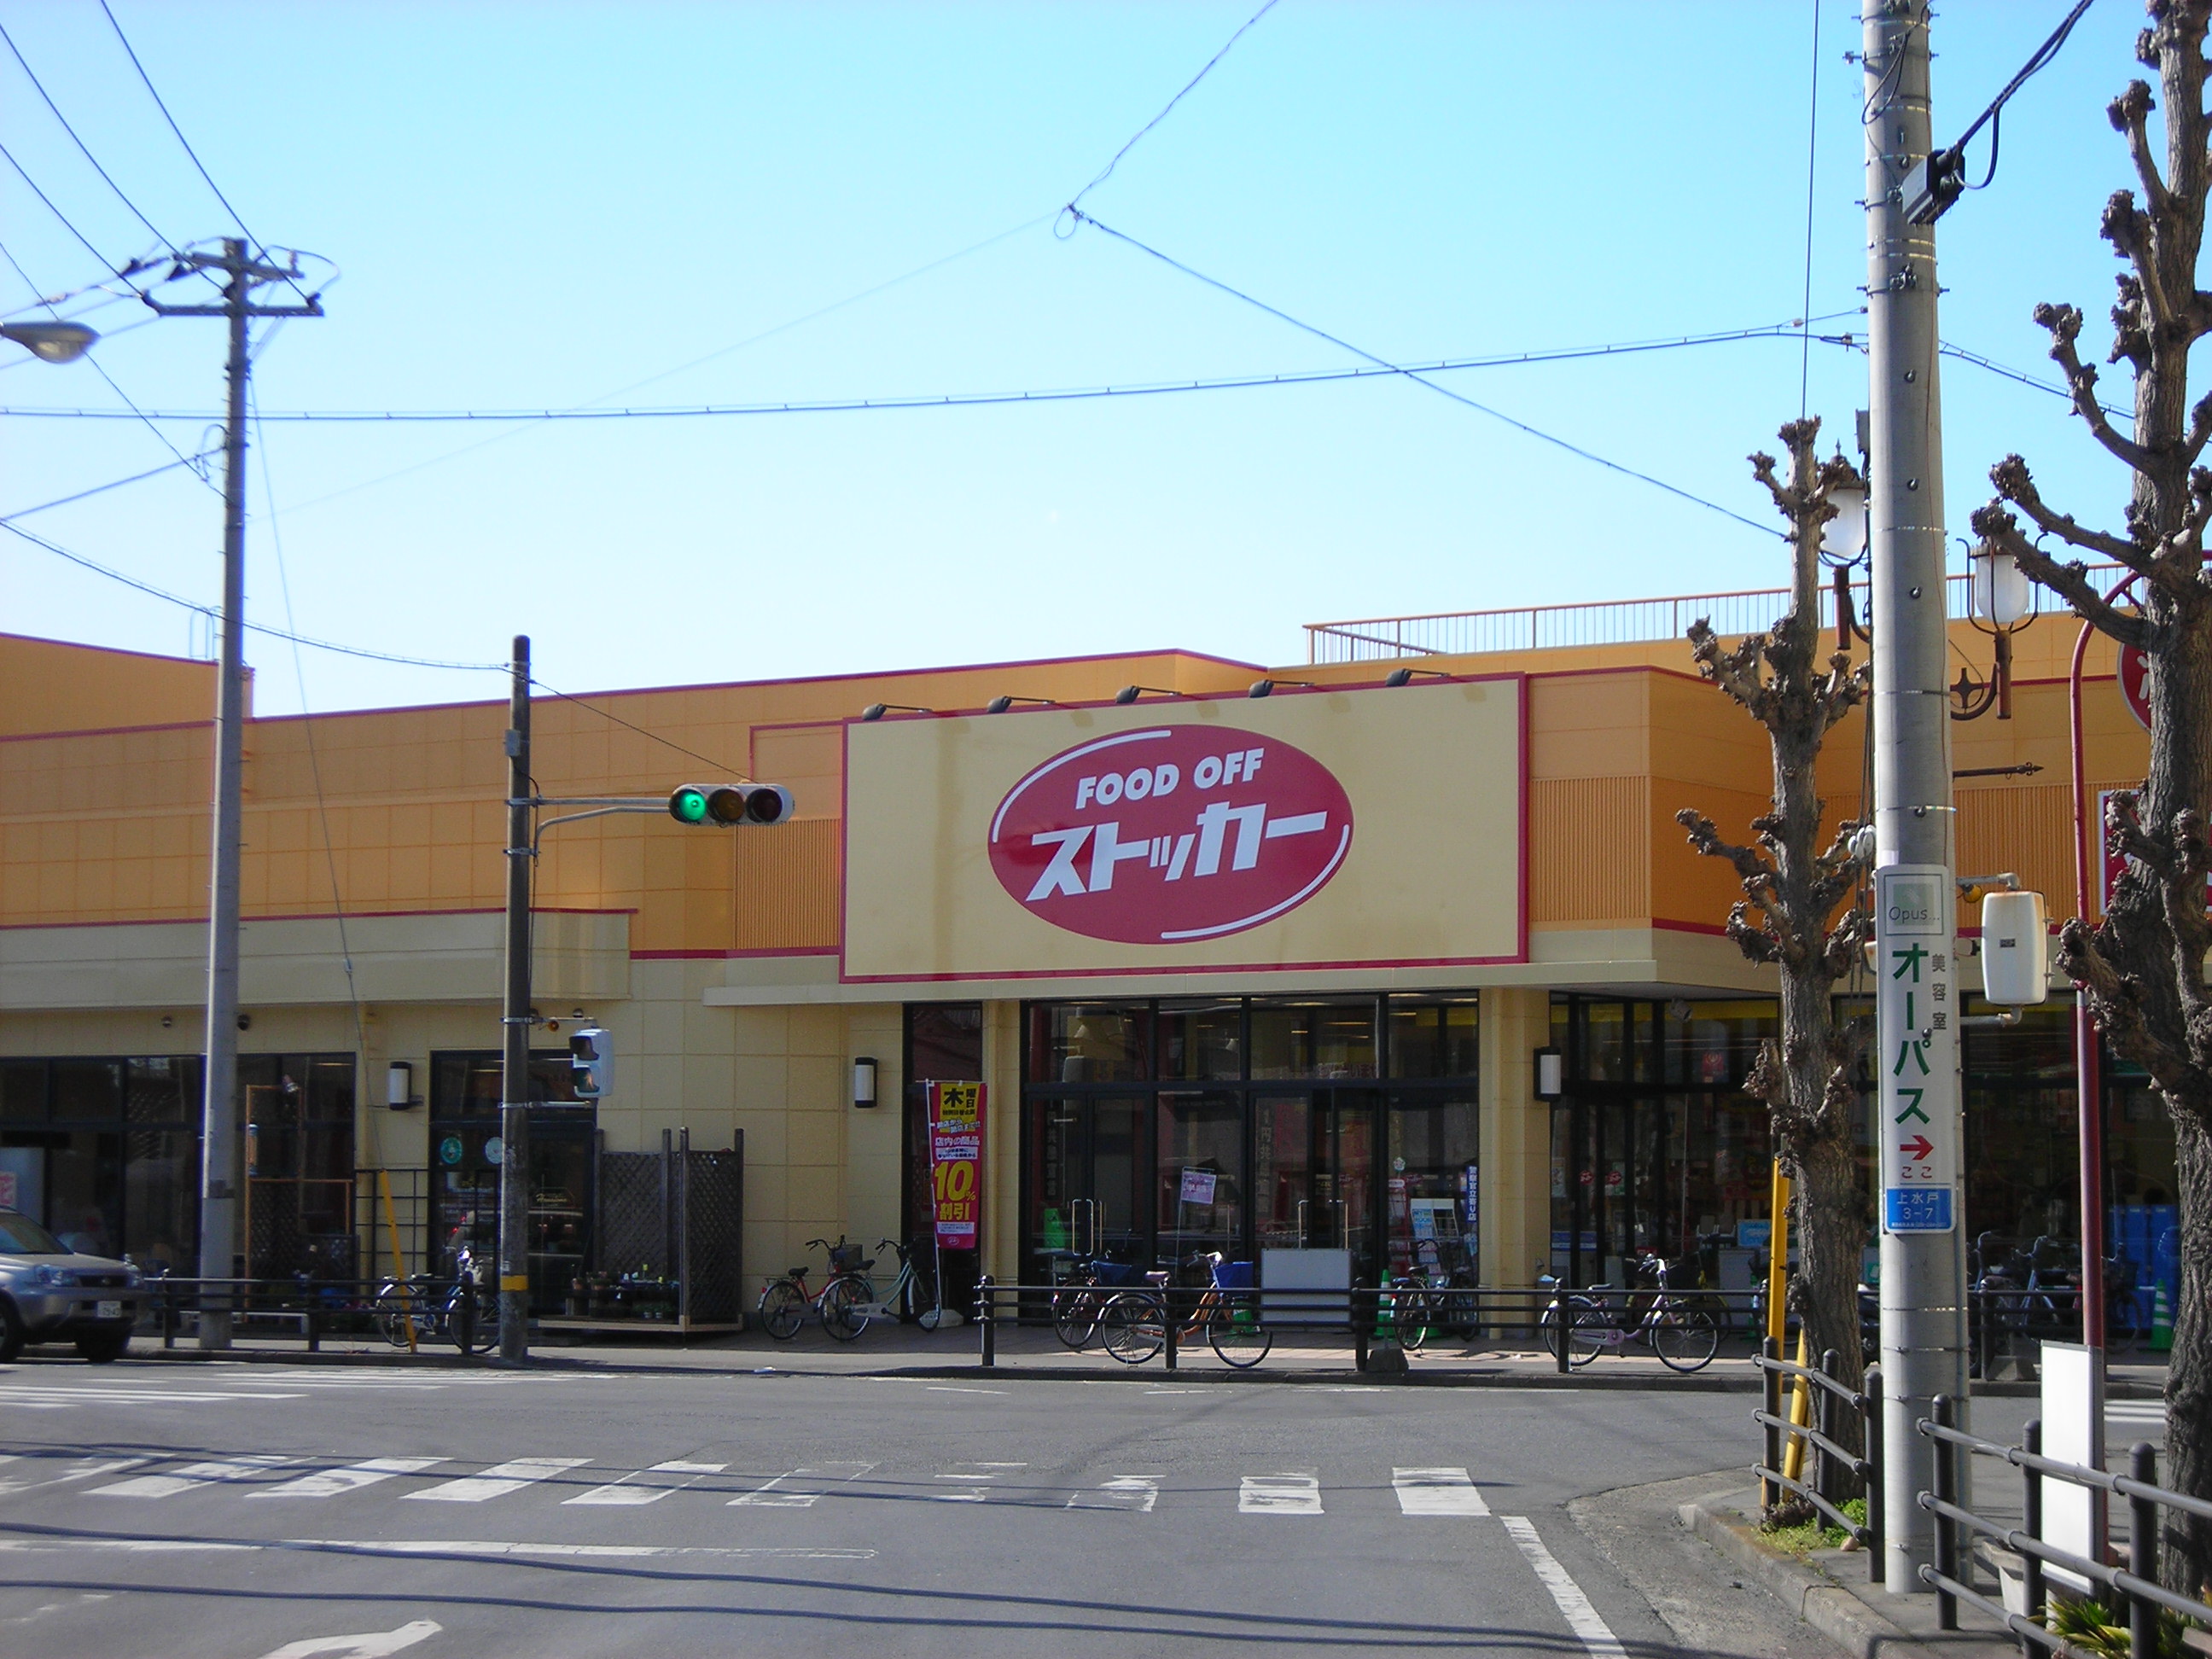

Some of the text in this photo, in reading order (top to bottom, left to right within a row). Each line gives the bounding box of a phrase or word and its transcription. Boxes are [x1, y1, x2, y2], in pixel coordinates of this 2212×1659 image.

[1075, 748, 1265, 809] FOOD OFF
[1026, 801, 1328, 902] ストッカー
[1931, 953, 1947, 1031] 美容室
[1892, 942, 1931, 1125] オーパス
[1901, 1165, 1933, 1179] ここ
[940, 1202, 970, 1221] 割引
[1896, 1191, 1939, 1204] 上水戸
[1902, 1207, 1934, 1220] 3-7
